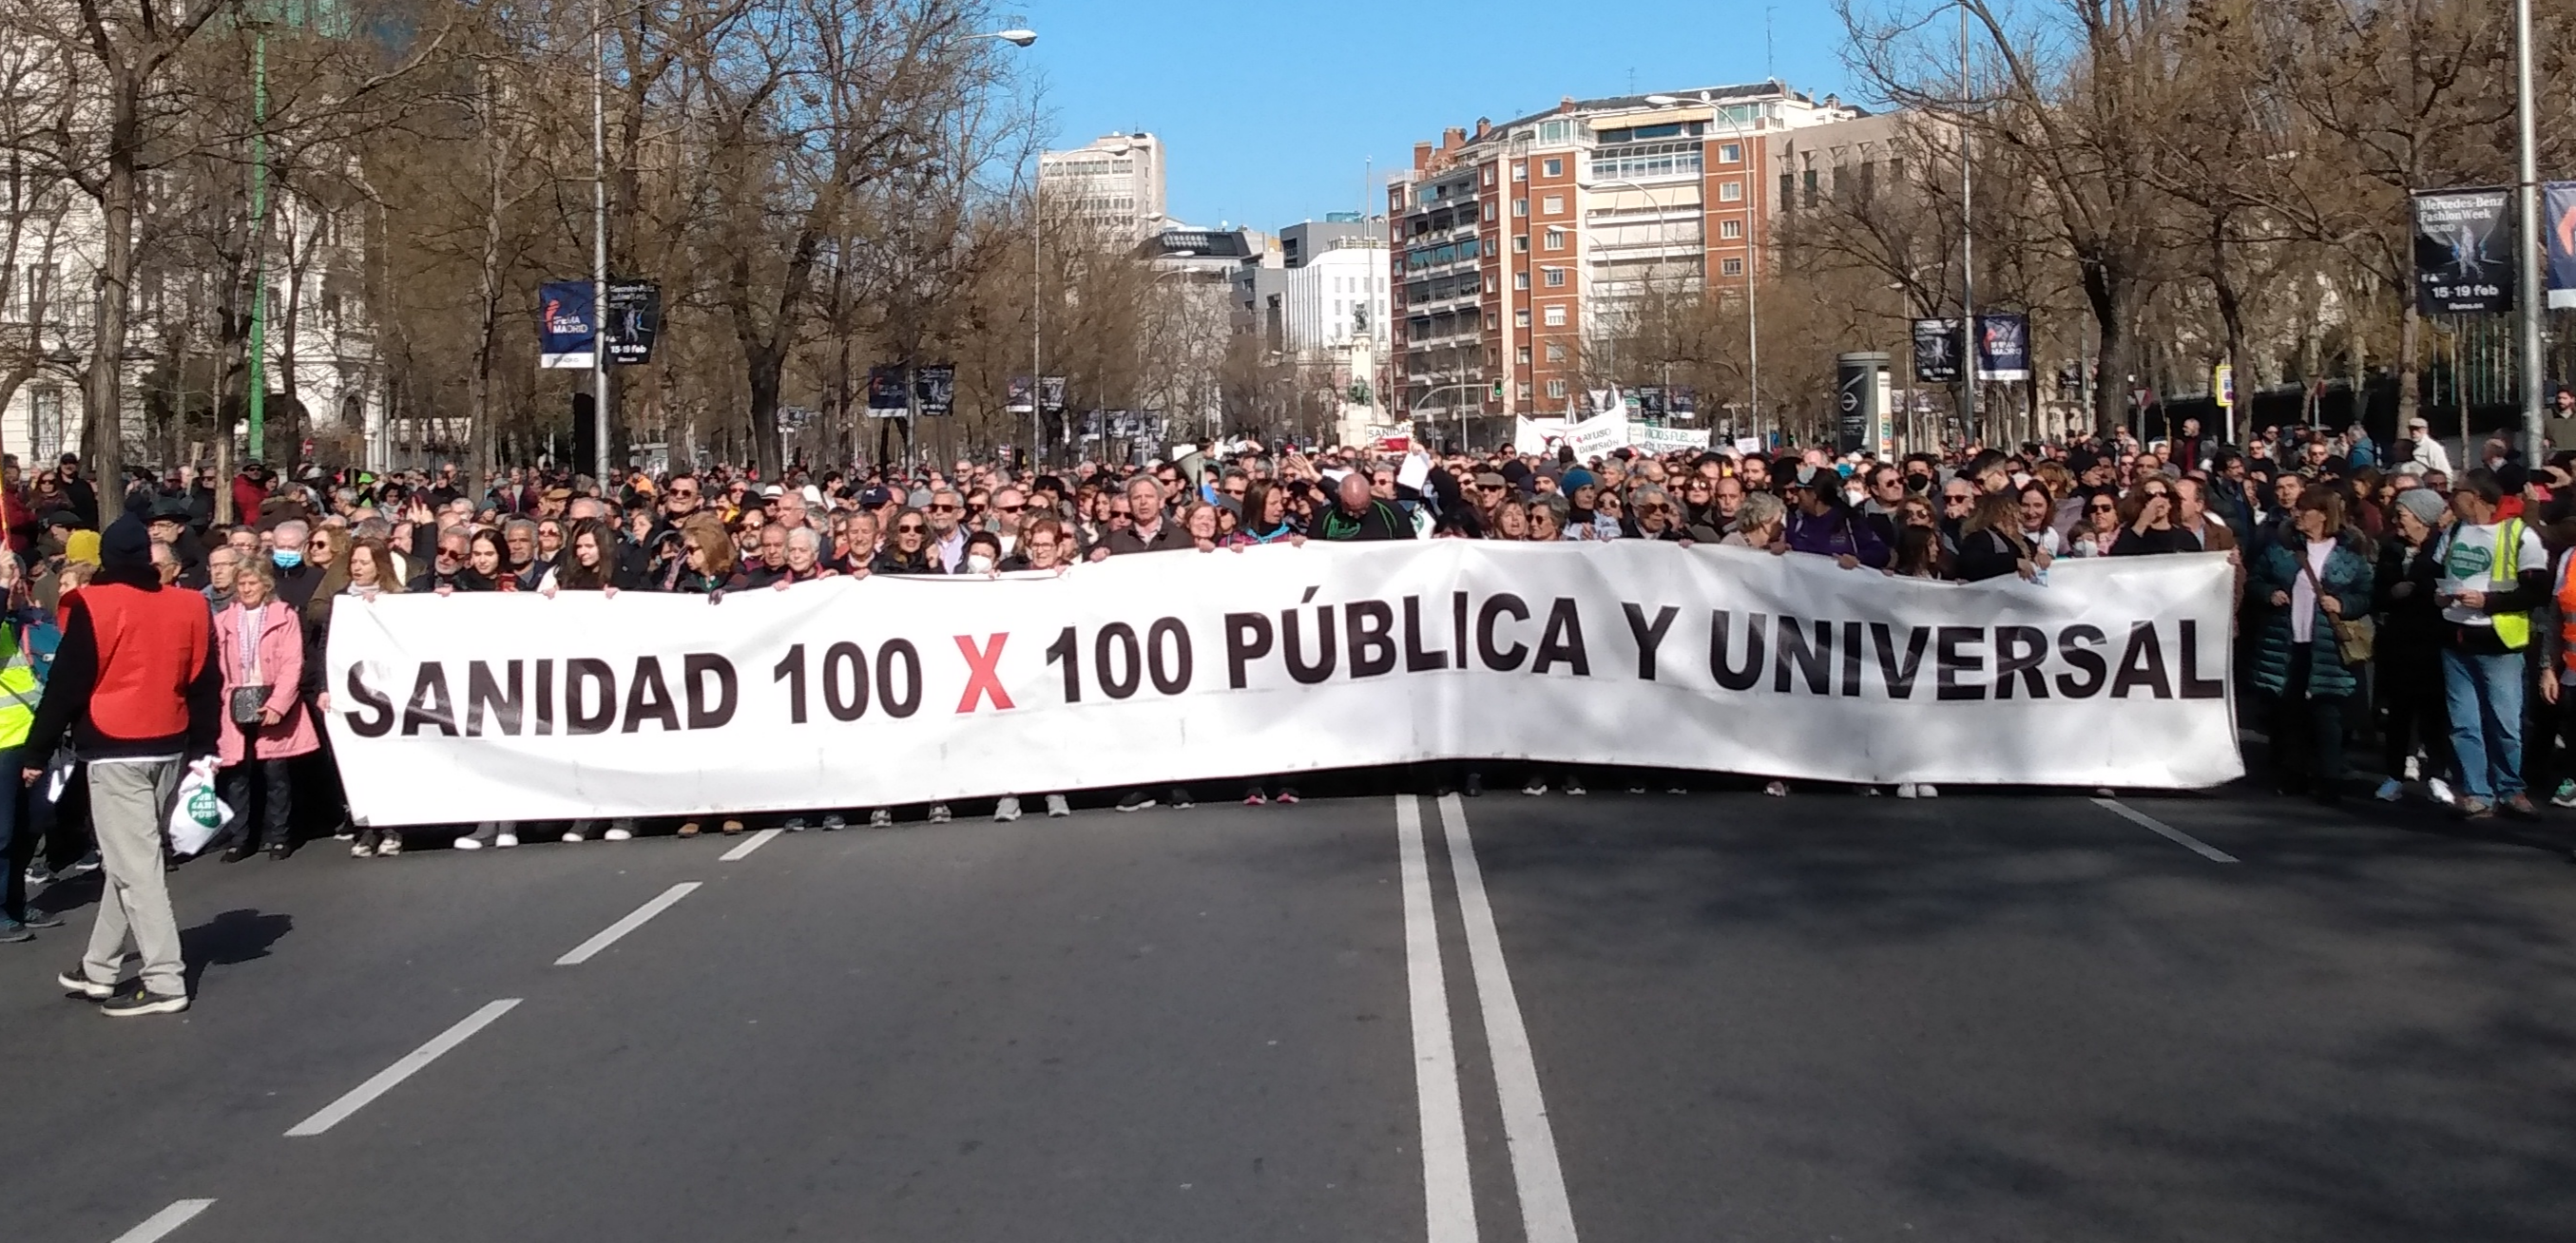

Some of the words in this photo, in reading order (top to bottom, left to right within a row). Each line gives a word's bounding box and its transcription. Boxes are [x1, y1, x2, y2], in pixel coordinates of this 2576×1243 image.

[2419, 197, 2504, 211] Mercedes-Benz
[2432, 285, 2471, 298] 15-19
[2473, 284, 2499, 296] feb
[553, 324, 588, 334] MADRID
[1583, 428, 1612, 441] AYUSO
[346, 651, 739, 737] SANIDAD
[774, 637, 923, 724] 100
[952, 632, 1015, 715] X
[1047, 616, 1193, 703] 100
[1224, 585, 1592, 689] PÚBLICA
[1621, 601, 1681, 680] Y
[1710, 609, 2224, 701] UNIVERSAL
